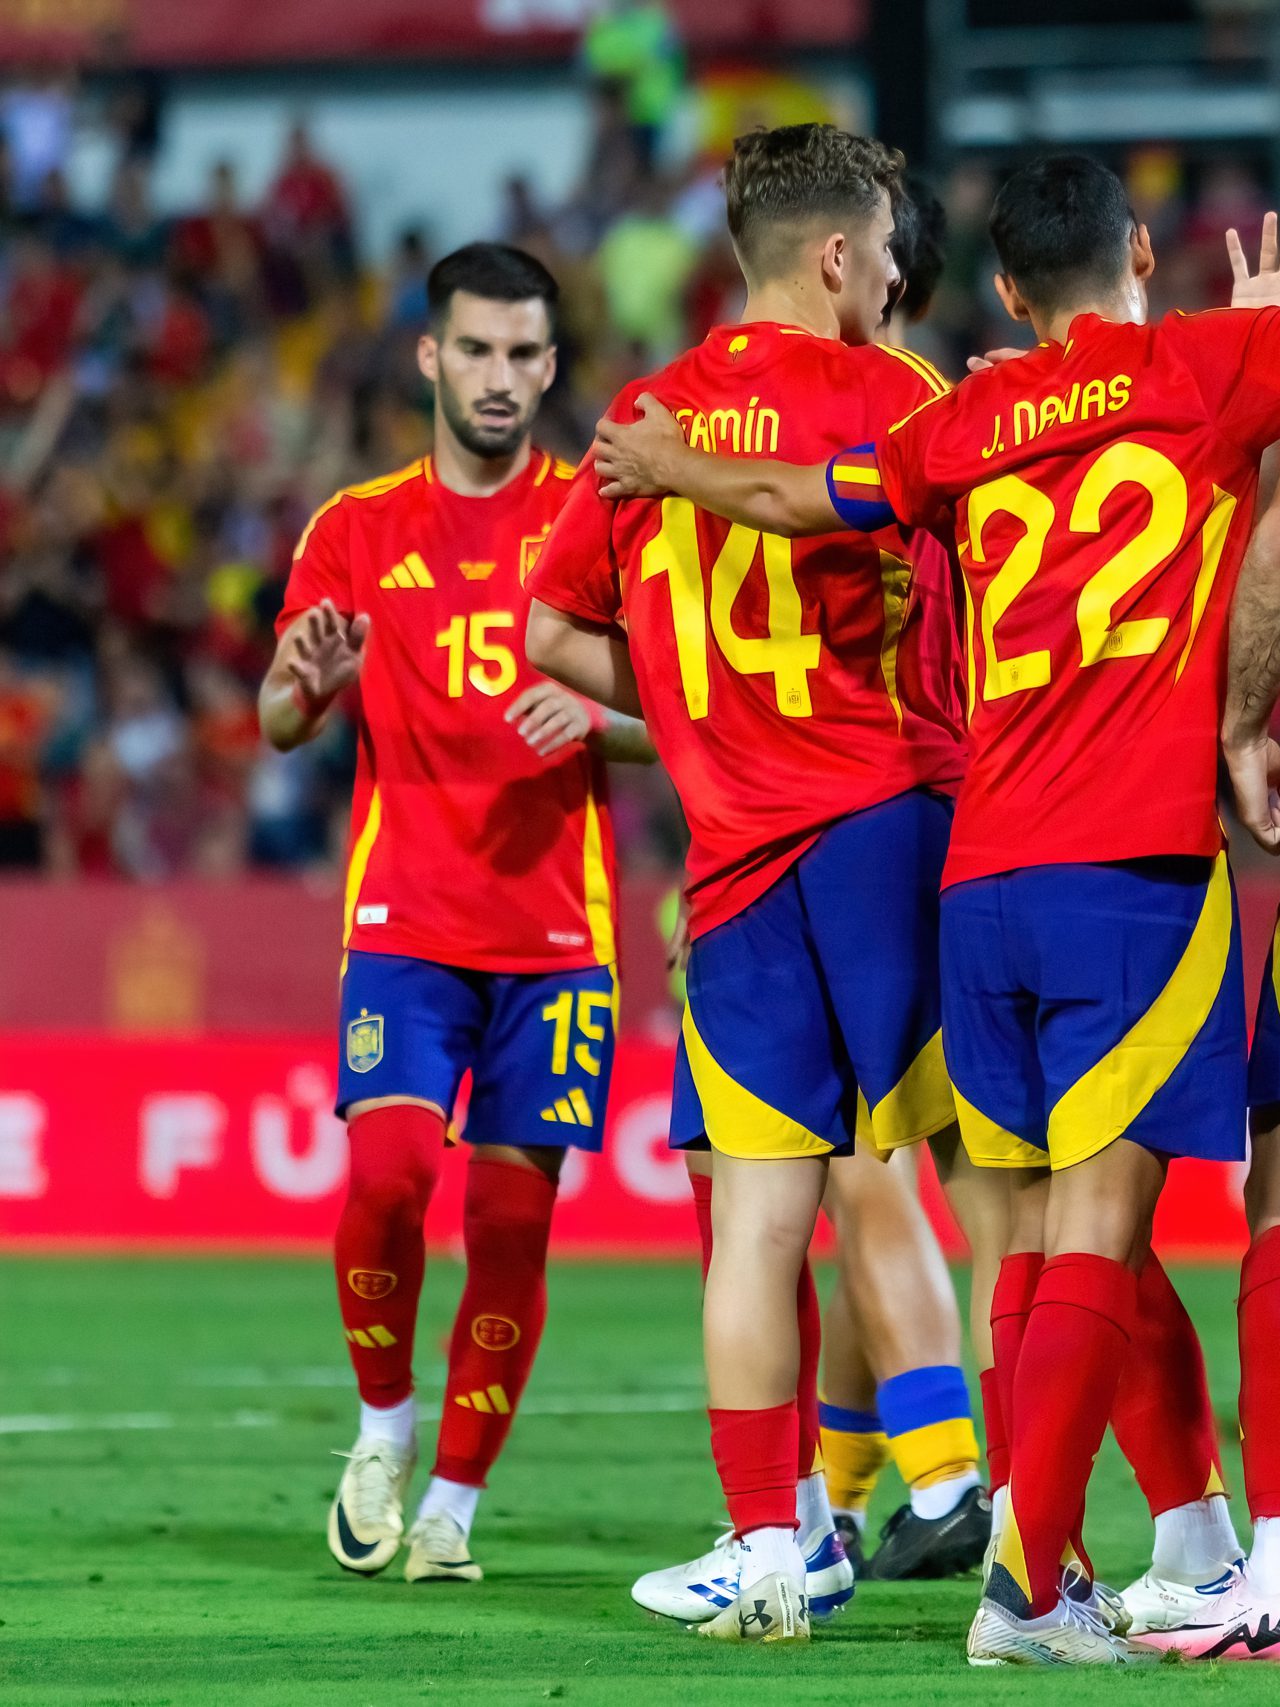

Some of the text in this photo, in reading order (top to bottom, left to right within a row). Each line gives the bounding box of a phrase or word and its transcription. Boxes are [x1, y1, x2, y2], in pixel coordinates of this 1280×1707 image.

[981, 415, 1005, 460] J.
[641, 497, 821, 720] 14
[968, 442, 1188, 702] 22
[436, 611, 517, 698] 15
[542, 990, 612, 1077] 15
[1158, 1592, 1179, 1605] COPA
